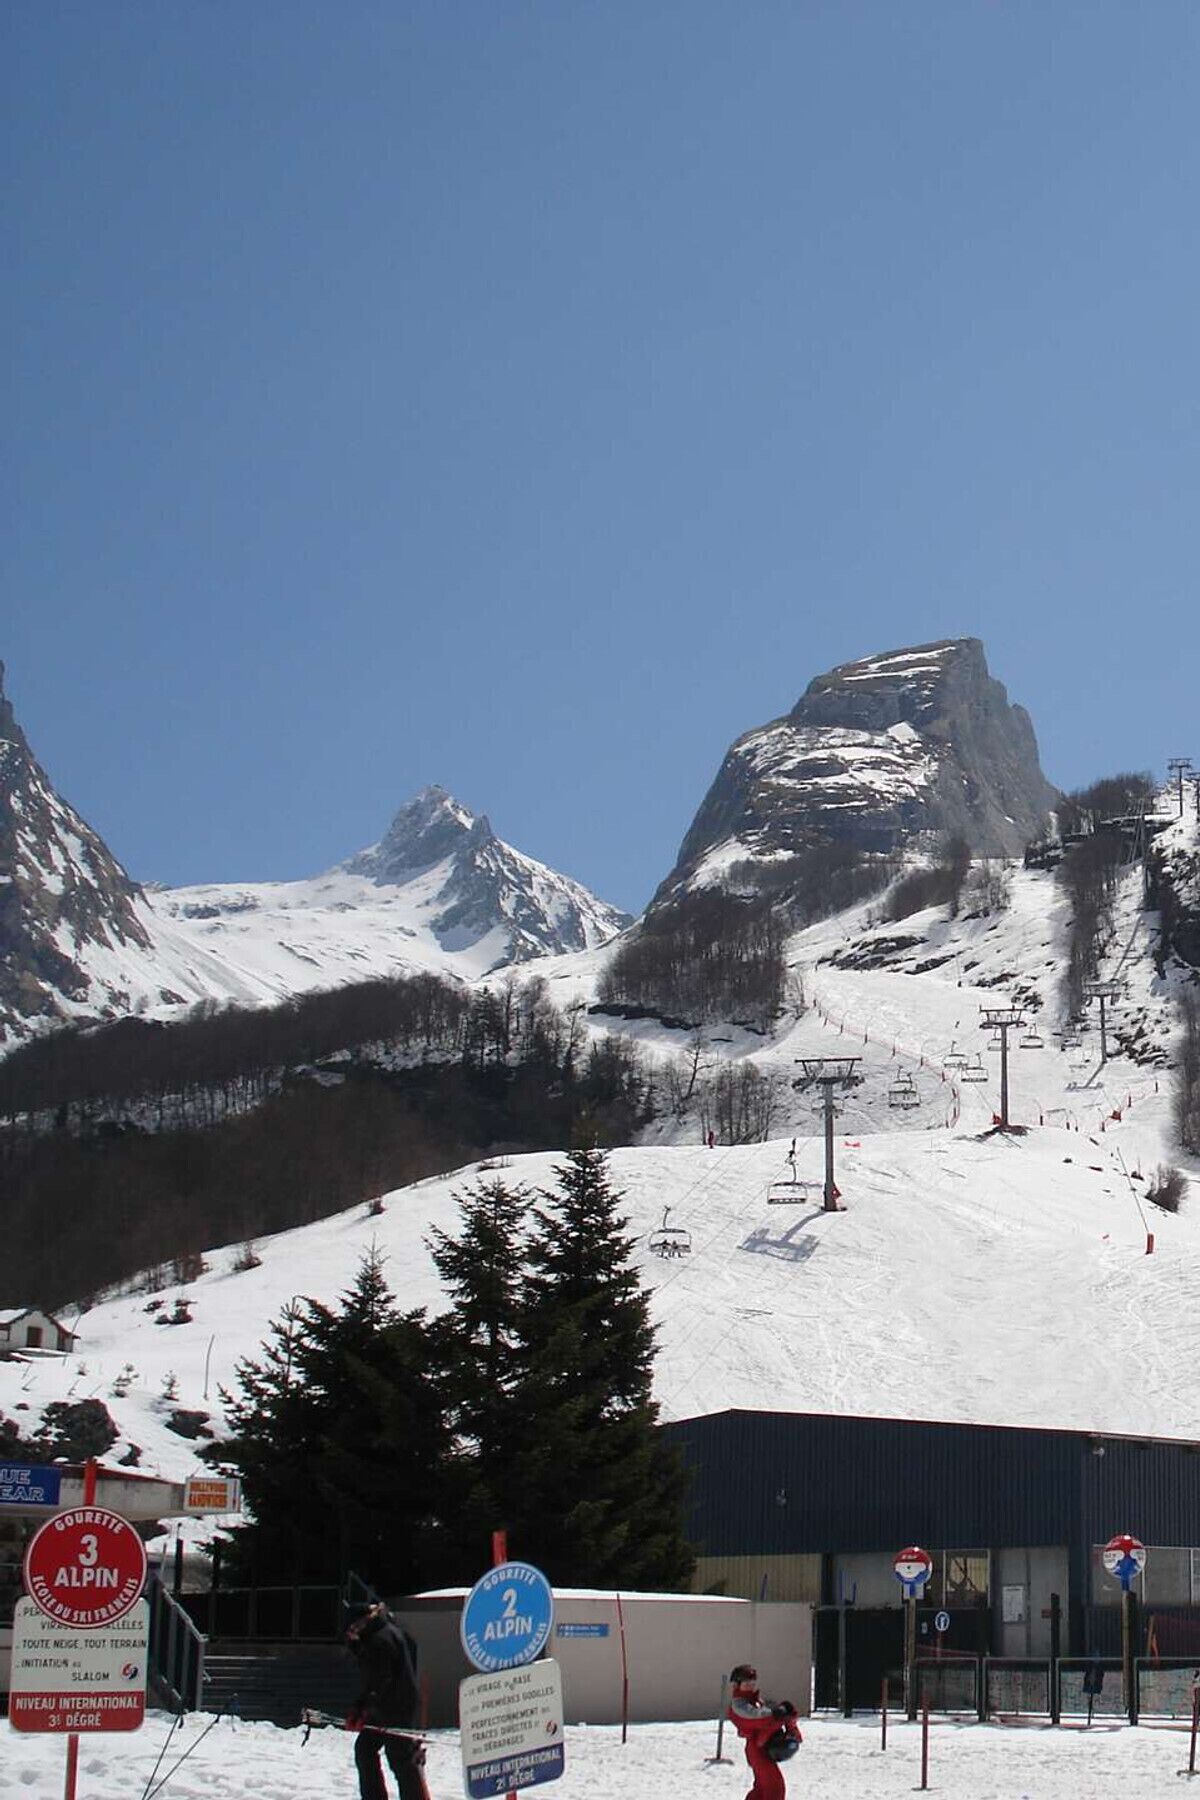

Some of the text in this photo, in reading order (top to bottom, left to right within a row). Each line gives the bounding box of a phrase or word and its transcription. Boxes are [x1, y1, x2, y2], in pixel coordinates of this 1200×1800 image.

[54, 1511, 125, 1534] GOURETTE
[78, 1534, 98, 1567] 3
[54, 1566, 119, 1588] ALPIN
[54, 1603, 71, 1619] DU
[72, 1609, 92, 1622] SKI
[502, 1588, 517, 1618] 2
[483, 1615, 532, 1640] ALPIN
[22, 1639, 50, 1649] TOUTE
[84, 1639, 106, 1649] TOUT
[110, 1639, 147, 1649] TERRAIN
[71, 1672, 110, 1681] SLALOM
[16, 1696, 139, 1710] NIVEAU INTERNATIONAL
